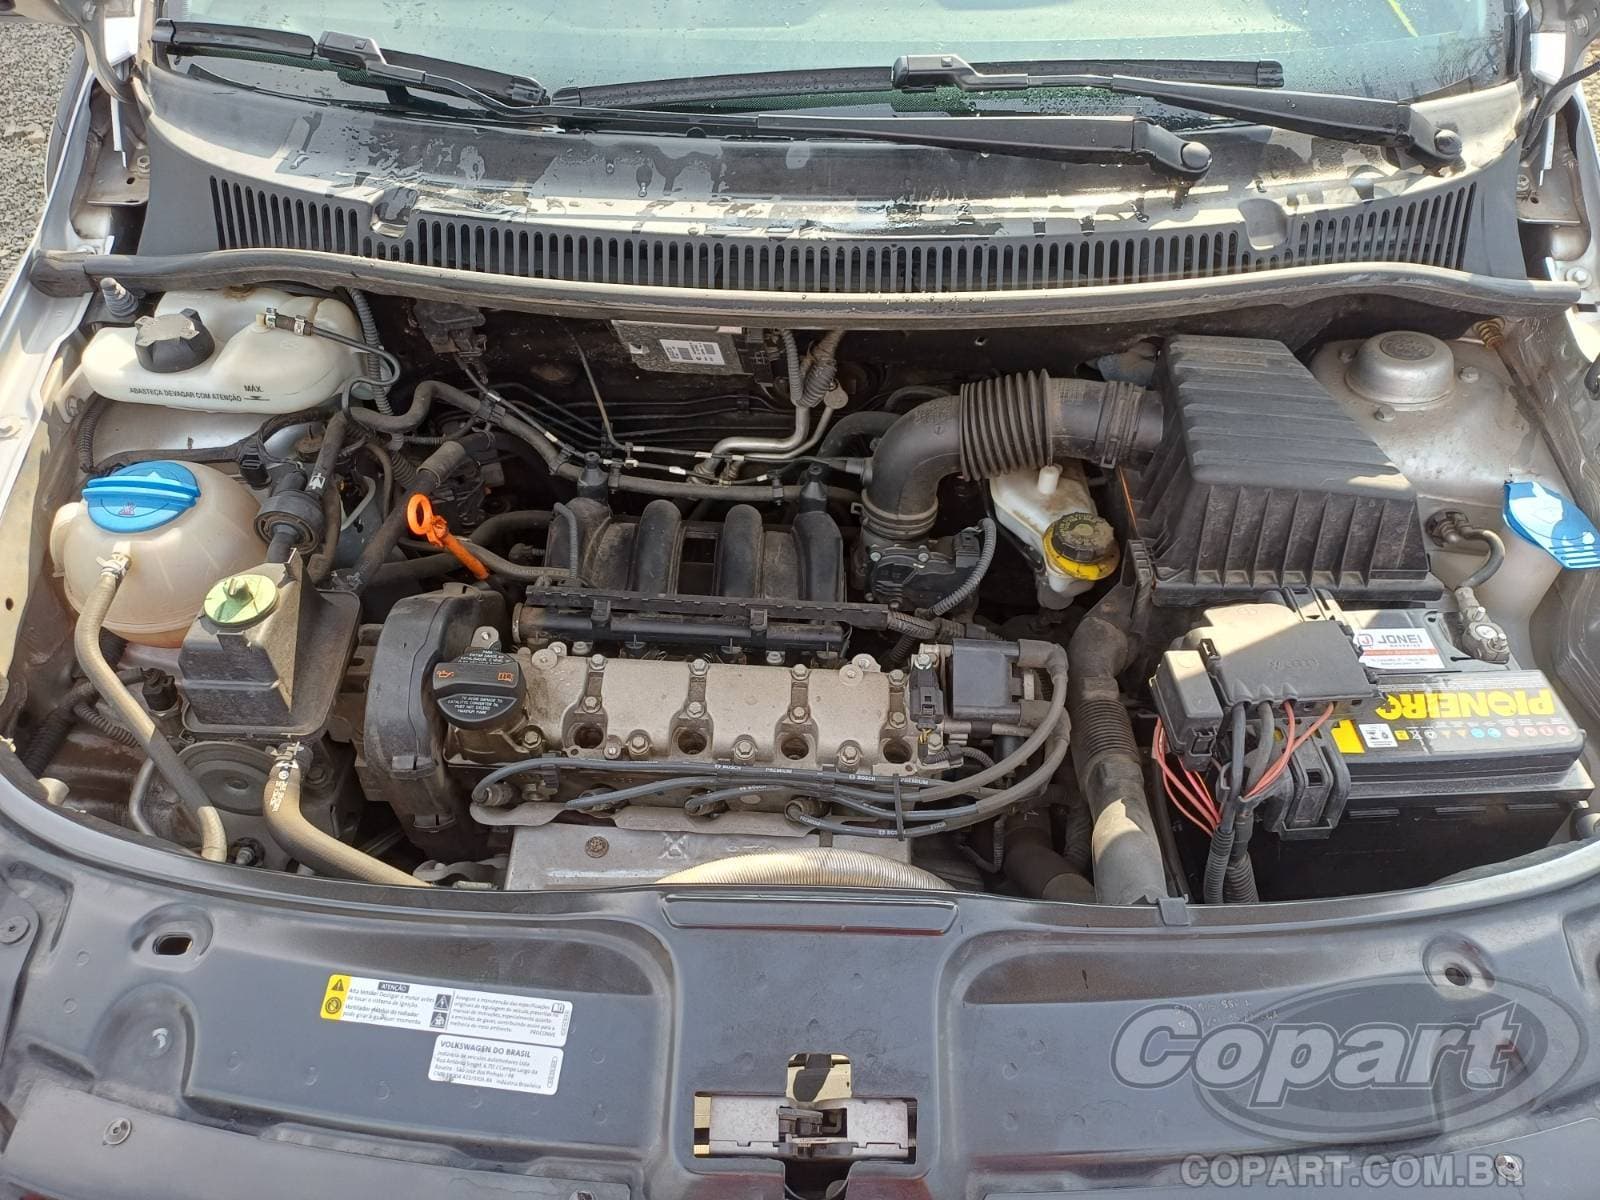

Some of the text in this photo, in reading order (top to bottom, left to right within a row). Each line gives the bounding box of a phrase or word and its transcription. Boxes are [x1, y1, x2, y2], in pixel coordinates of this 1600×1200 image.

[129, 387, 242, 401] ABASTEÇA DEVAGAR COM ATENÇÃO
[380, 983, 407, 992] ATENÇÃO
[439, 1040, 491, 1052] VOLKSWAGEN
[506, 1048, 531, 1057] BRASIL
